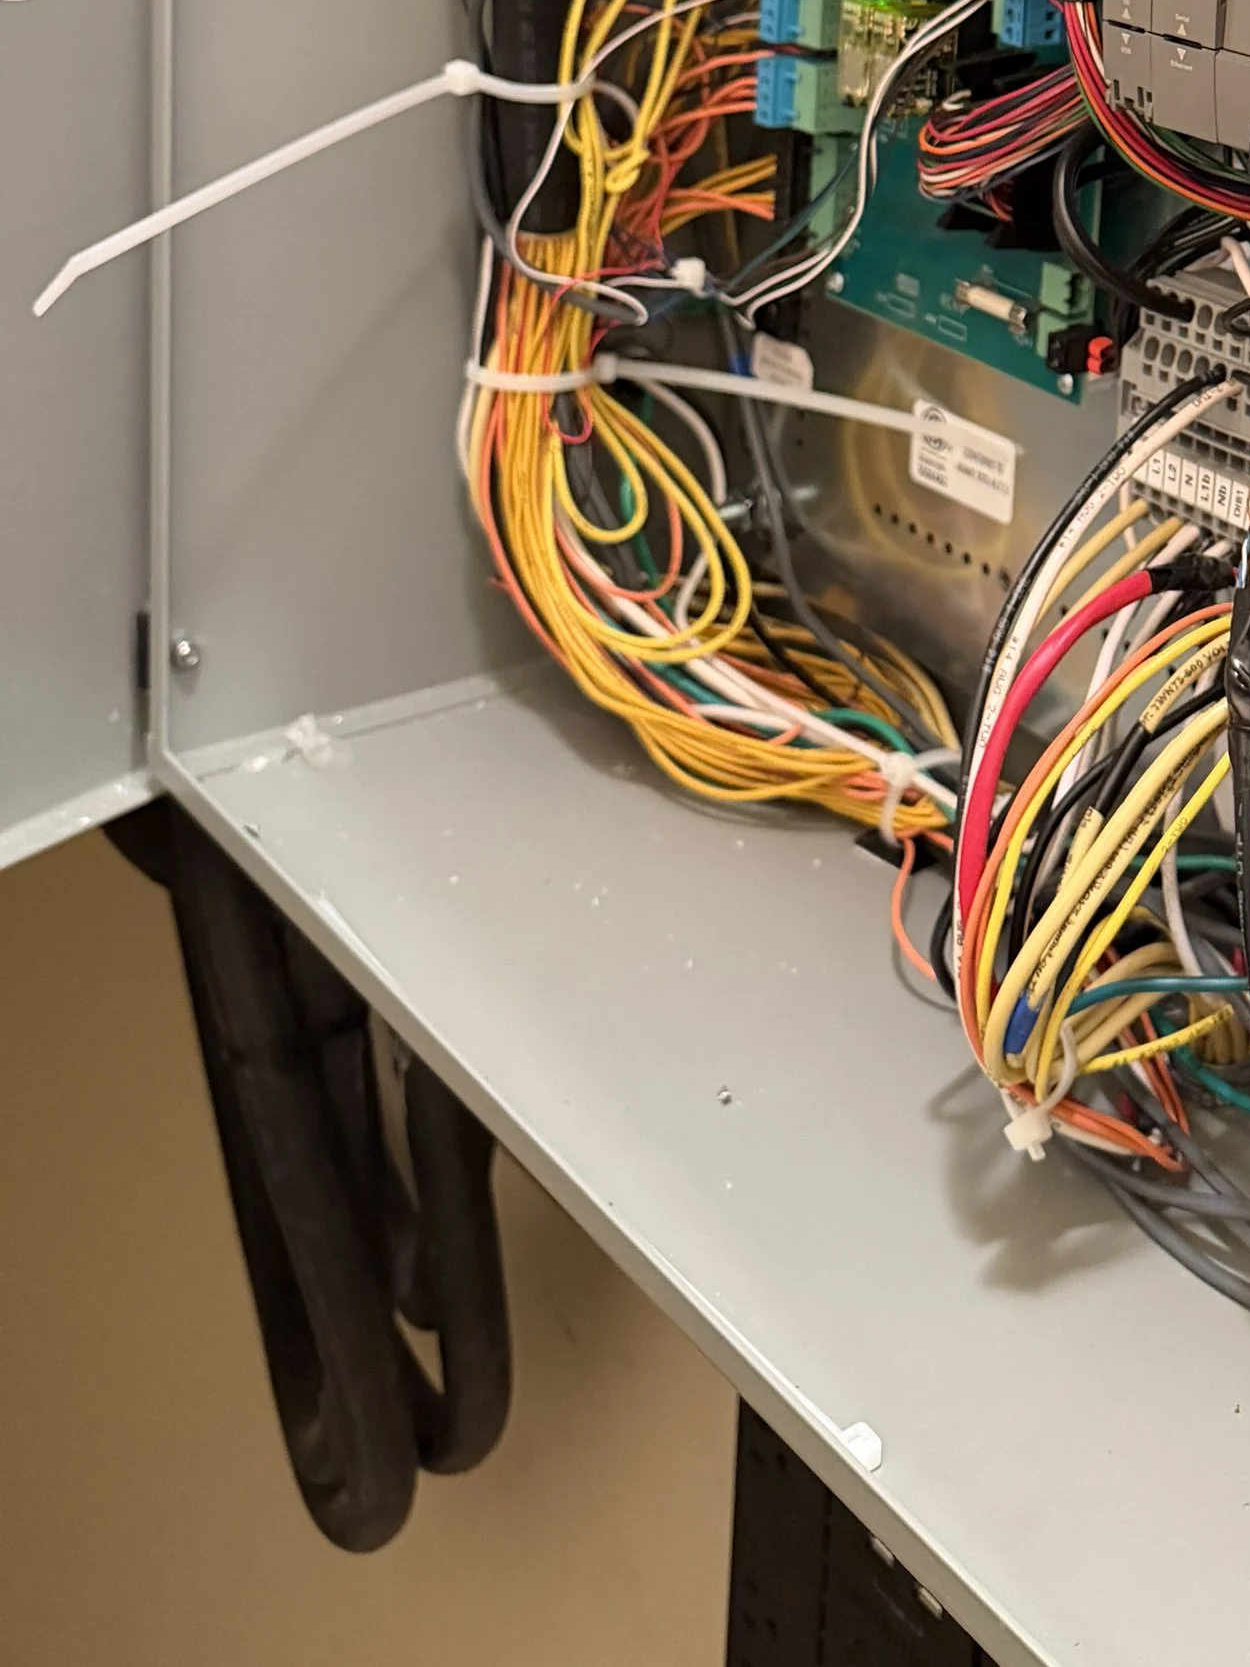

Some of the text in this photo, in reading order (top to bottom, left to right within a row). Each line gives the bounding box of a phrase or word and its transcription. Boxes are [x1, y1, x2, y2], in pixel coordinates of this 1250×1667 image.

[1152, 458, 1161, 474] L1
[1168, 464, 1178, 482] L2
[1185, 474, 1194, 487] N
